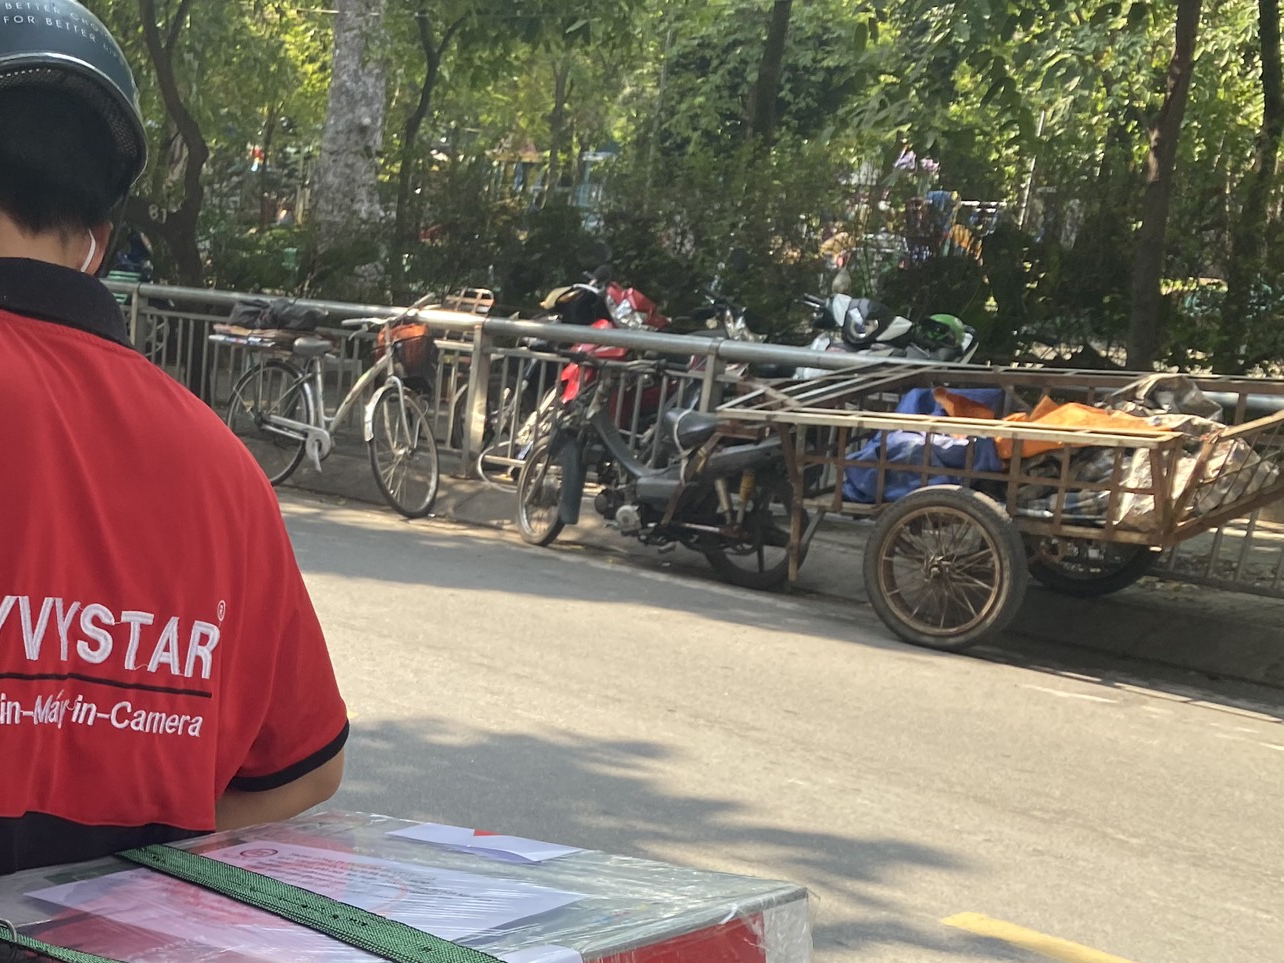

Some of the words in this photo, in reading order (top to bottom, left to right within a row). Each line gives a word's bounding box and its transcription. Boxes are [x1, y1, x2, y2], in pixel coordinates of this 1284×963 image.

[3, 15, 35, 24] FOR
[45, 17, 96, 42] BETTER
[71, 694, 203, 738] in-Camera
